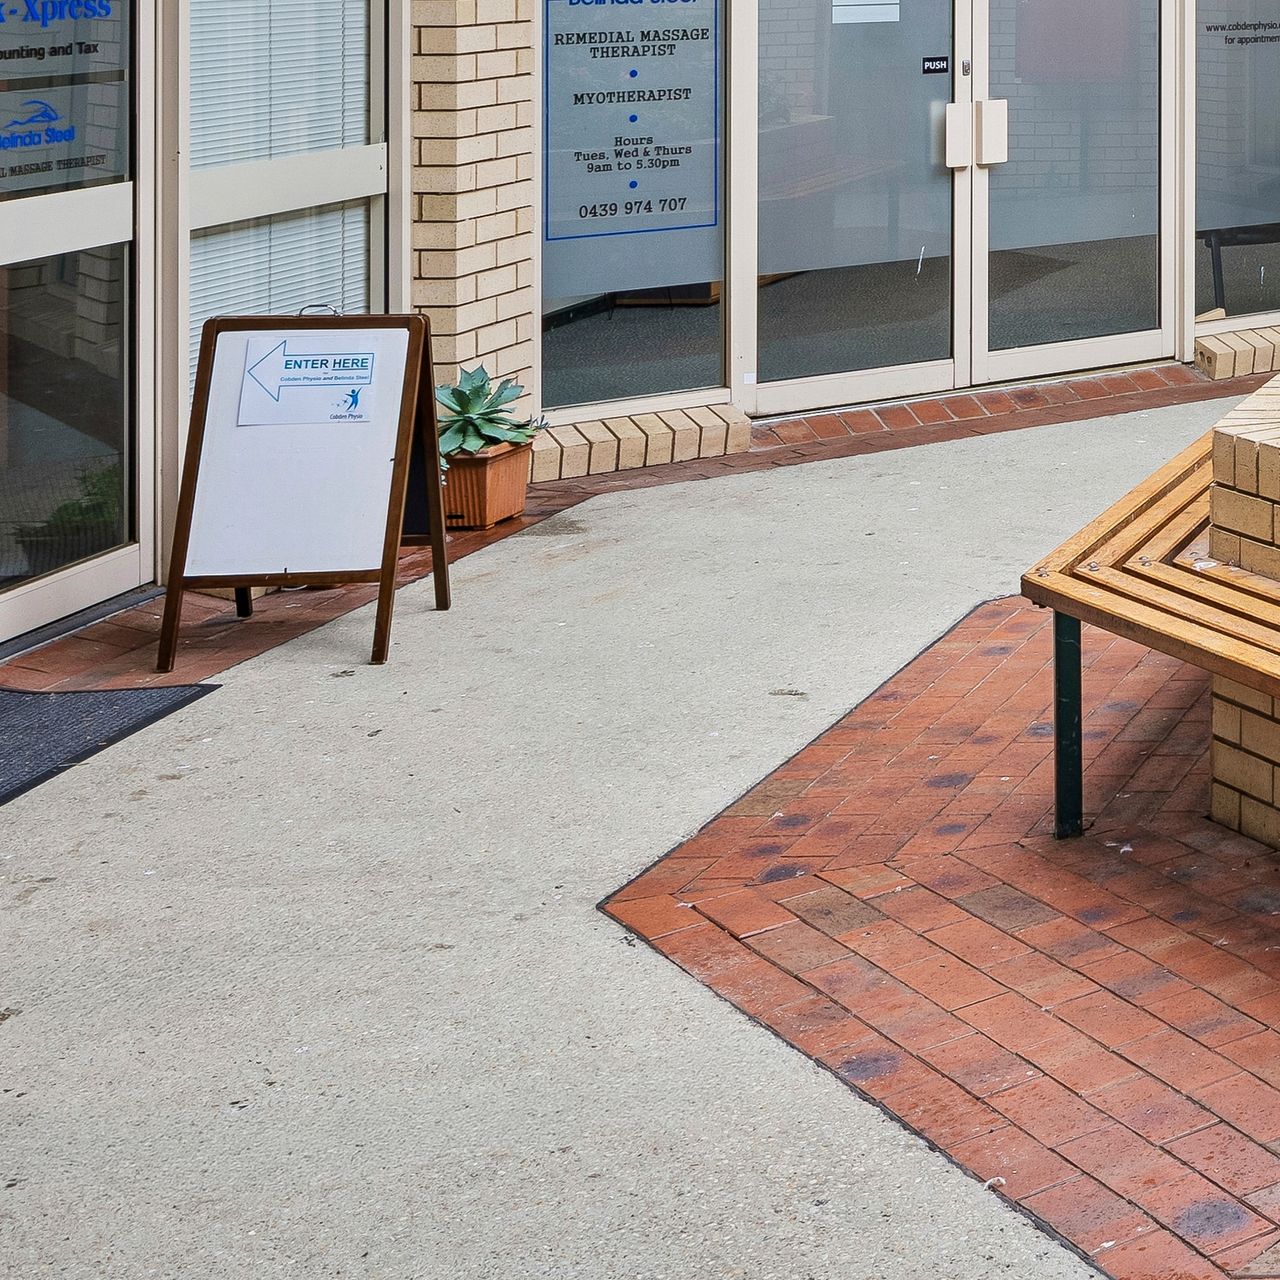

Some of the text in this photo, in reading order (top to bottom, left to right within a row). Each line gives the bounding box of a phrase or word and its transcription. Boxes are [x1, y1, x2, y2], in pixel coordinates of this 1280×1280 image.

[554, 28, 710, 46] REMEDIAL MASSAGE
[1224, 34, 1236, 45] for
[48, 43, 73, 57] and
[75, 41, 99, 55] Tax
[589, 44, 677, 59] THERAPIST
[924, 60, 947, 70] PUSH
[572, 88, 692, 106] MYOTHERAPIST
[614, 136, 654, 147] Hours
[614, 147, 639, 159] Wed
[642, 147, 651, 157] &
[654, 145, 692, 156] Thurs
[586, 157, 680, 173] 9am to 5.30pm
[579, 197, 688, 219] 0439 974 707
[284, 358, 369, 370] ENTER HERE
